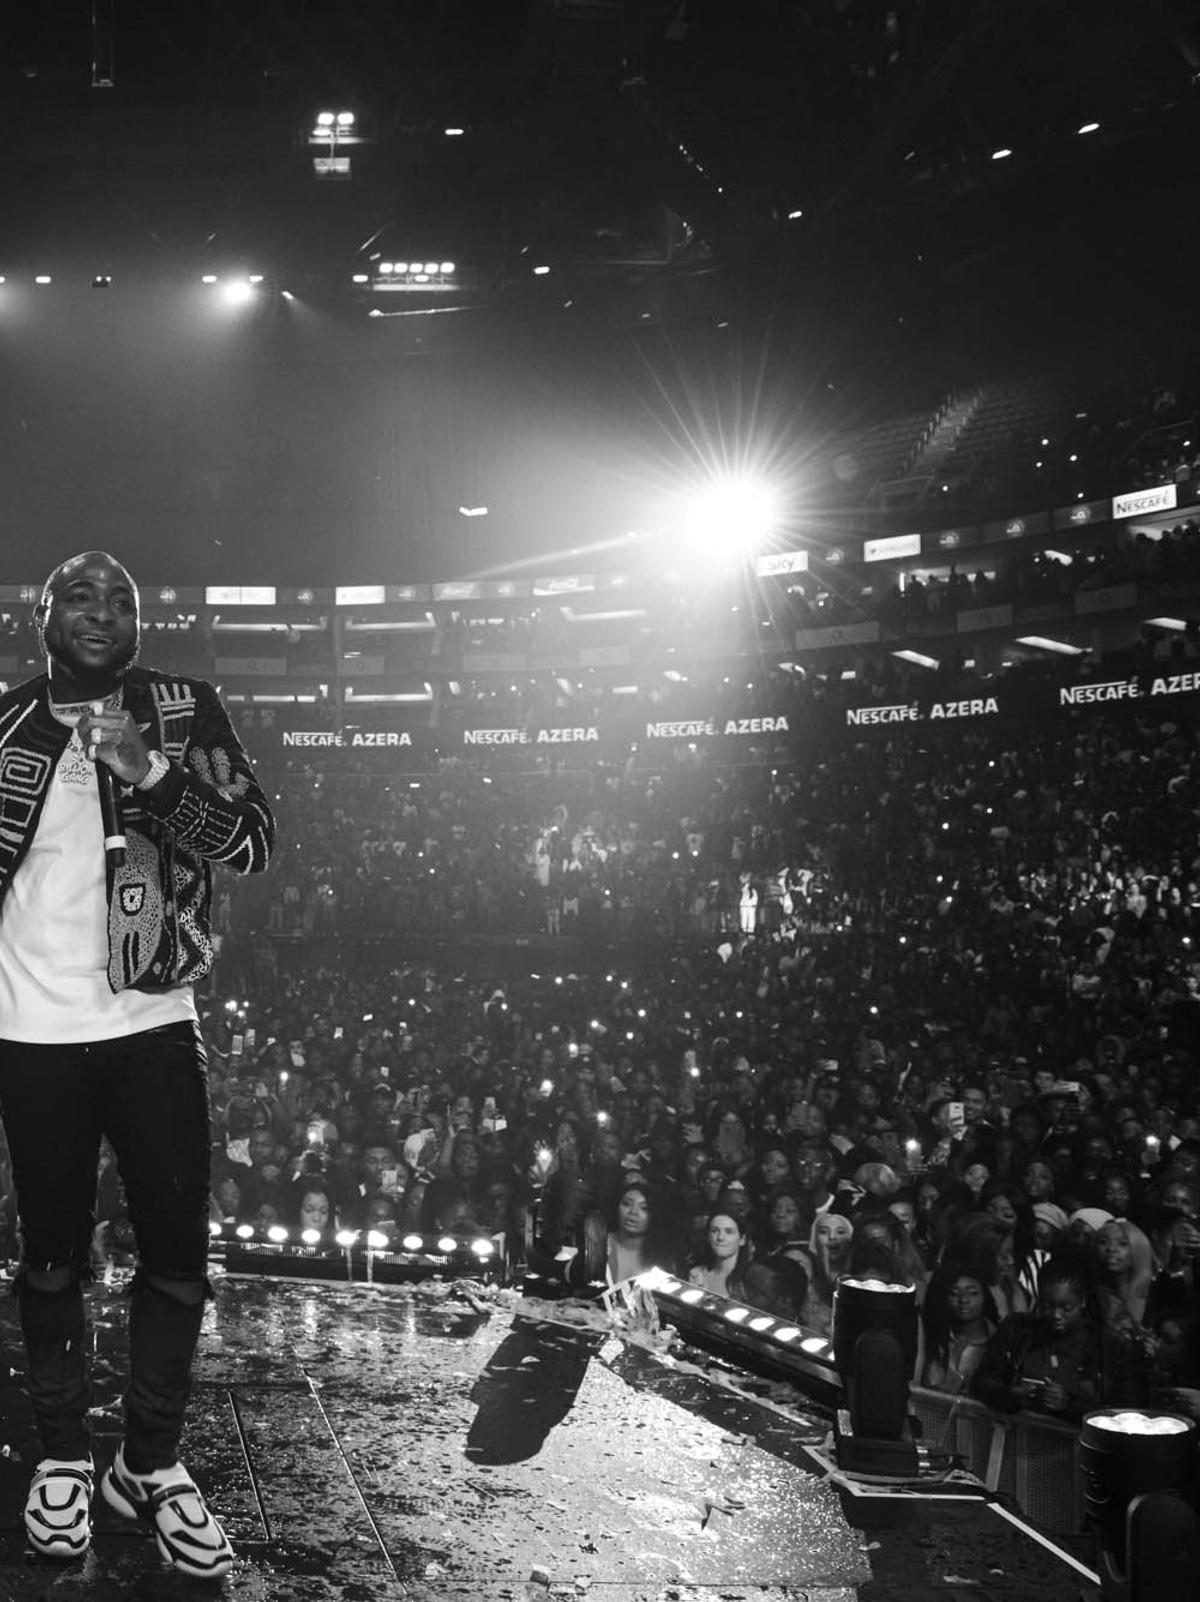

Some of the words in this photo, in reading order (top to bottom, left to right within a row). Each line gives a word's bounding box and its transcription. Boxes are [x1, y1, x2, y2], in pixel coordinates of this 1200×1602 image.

[1117, 490, 1169, 514] NESCAFÉ
[930, 697, 999, 720] AZERA
[536, 727, 599, 743] AZERA
[723, 716, 789, 735] AZERA
[351, 732, 412, 747] AZERA
